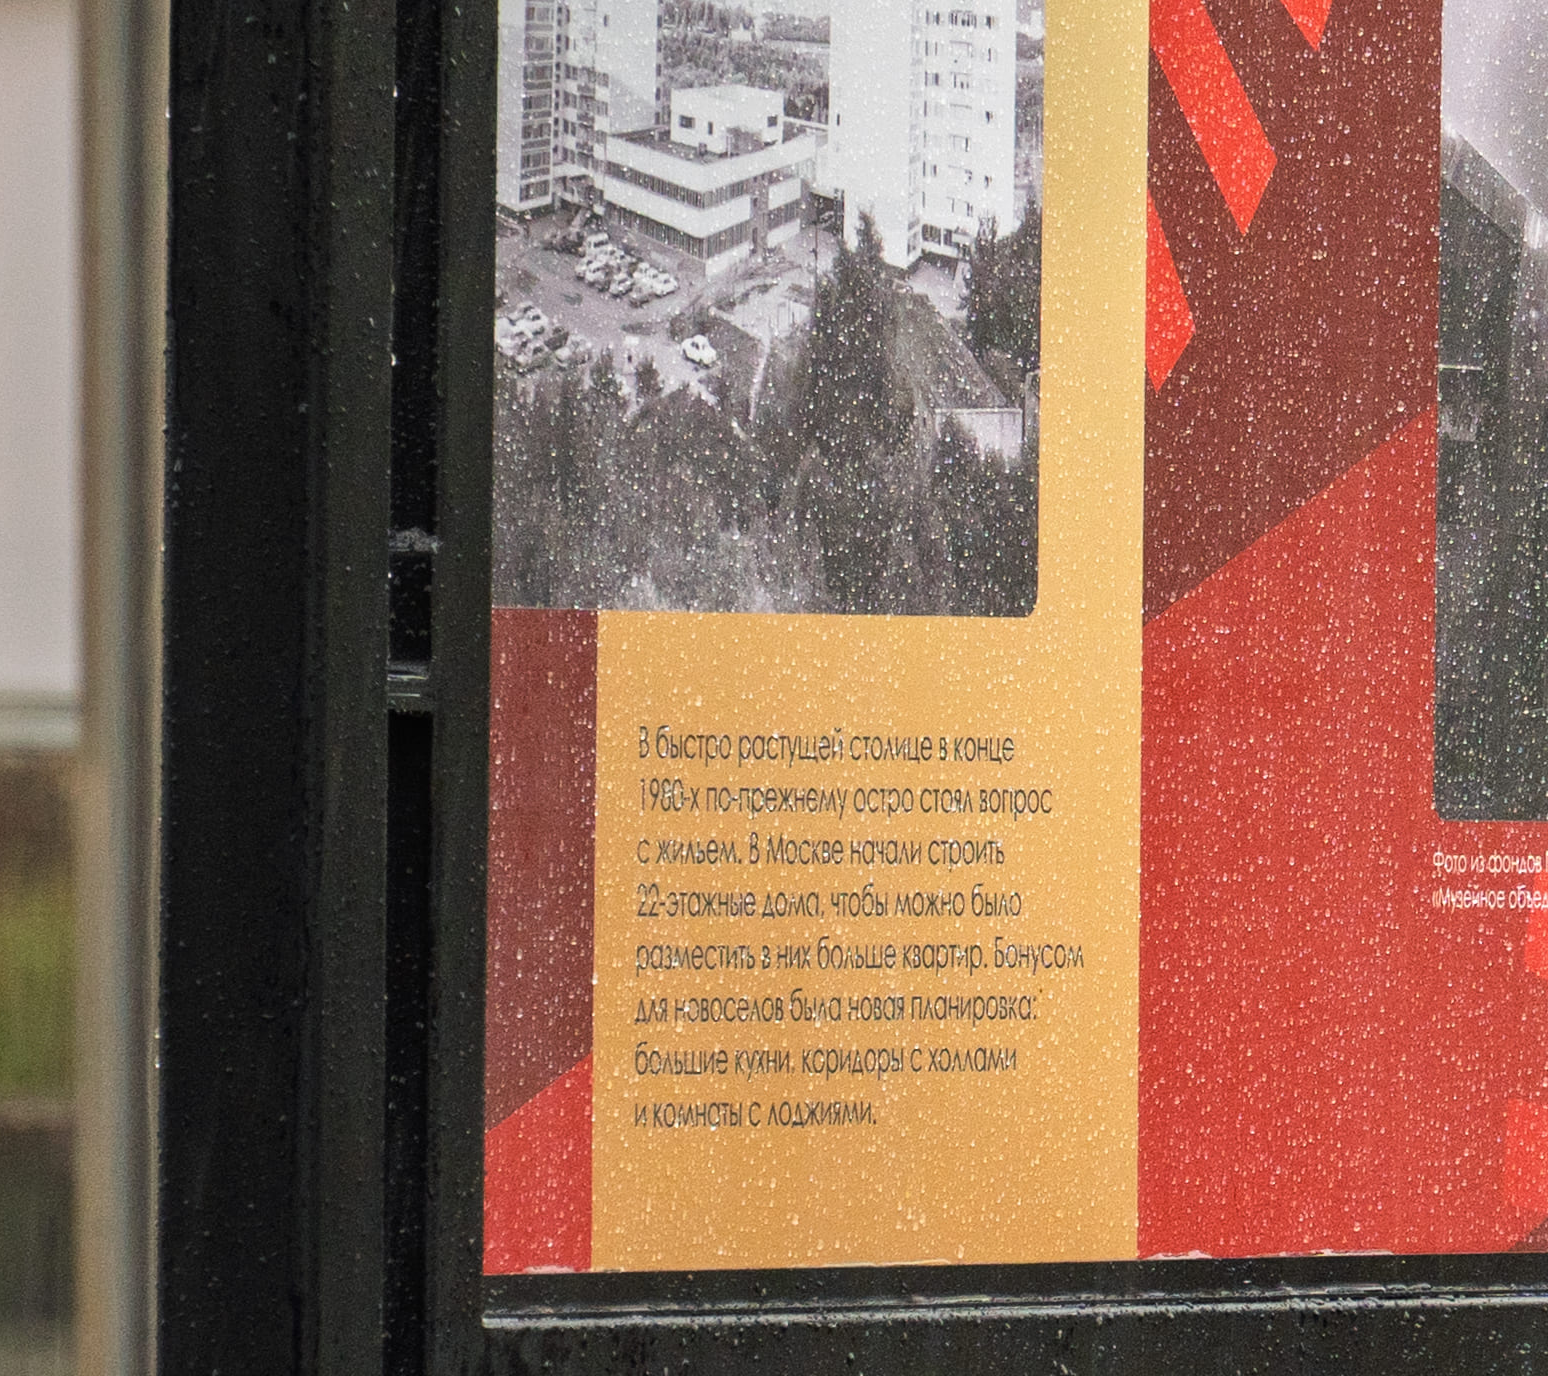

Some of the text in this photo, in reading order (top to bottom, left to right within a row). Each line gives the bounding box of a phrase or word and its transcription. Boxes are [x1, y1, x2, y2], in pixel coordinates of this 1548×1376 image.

[639, 725, 1014, 768] В быстро растущей столице в конце
[640, 778, 1052, 821] 1980-х по-прежнему остро стоял вопрос
[637, 832, 1004, 872] с жильем. В Москве начали строить
[1433, 852, 1466, 875] Фото
[1471, 856, 1485, 872] из
[1488, 852, 1542, 874] фондов
[637, 883, 1022, 919] 22-этажные дома, чтобы можно было
[1432, 885, 1504, 912] «Музейное
[636, 936, 1084, 977] разместить в них больше квартир. Бонусом
[635, 988, 1036, 1026] для новоселов была новая планировка:
[635, 1042, 728, 1074] большие
[802, 1048, 904, 1080] коридоры
[910, 1048, 922, 1072] с
[929, 1048, 1016, 1072] холлами
[634, 1101, 876, 1128] и комнаты с лоджиями.
